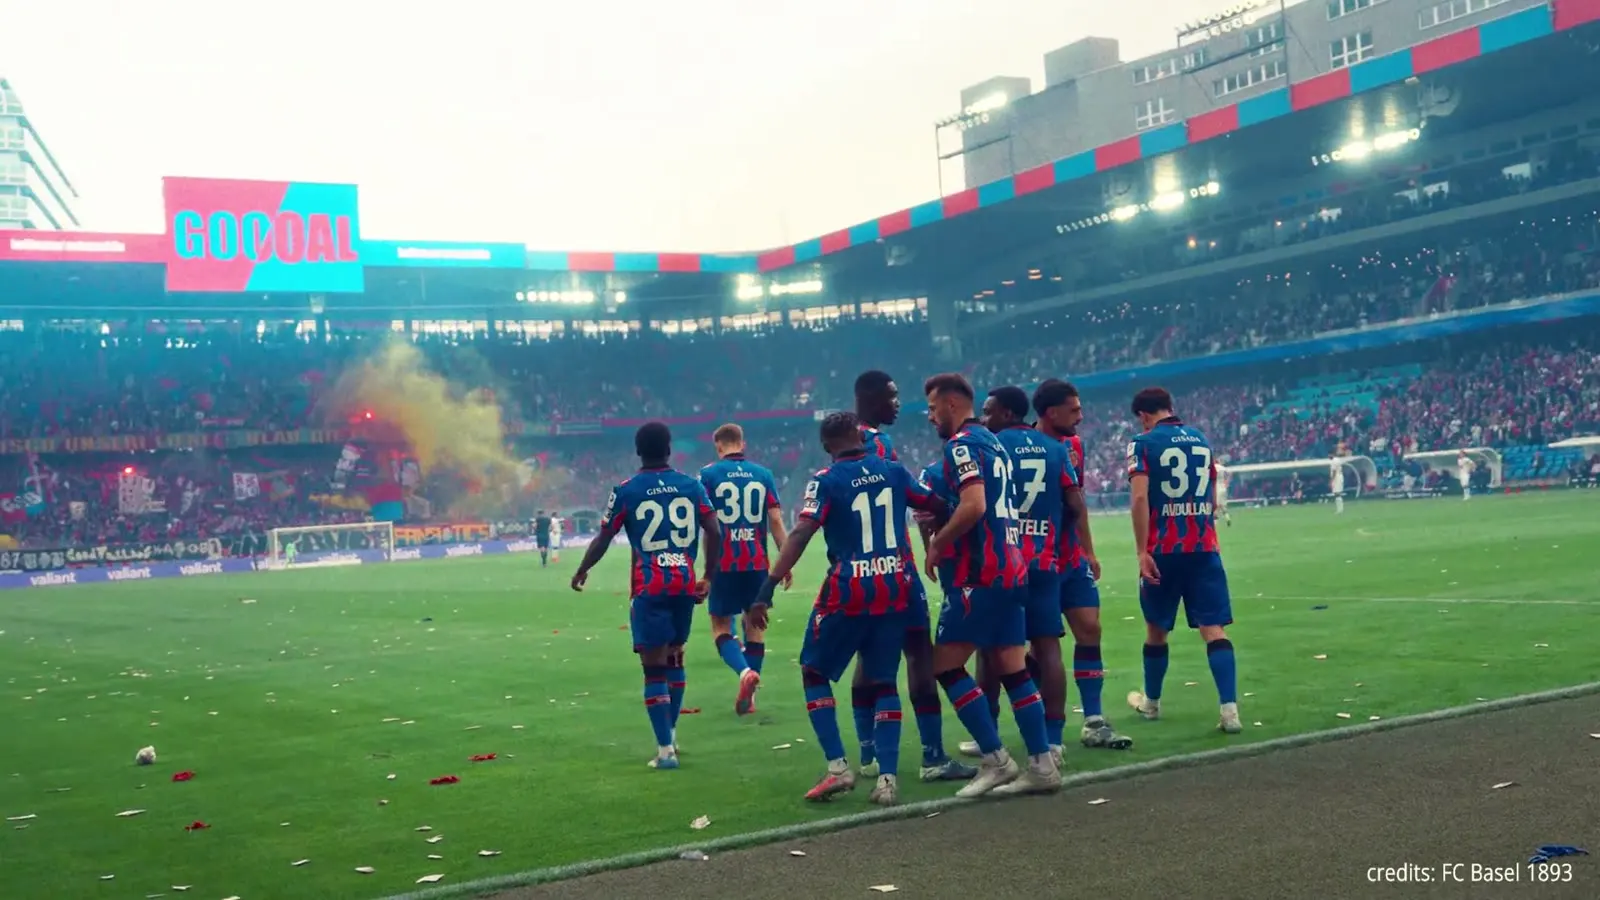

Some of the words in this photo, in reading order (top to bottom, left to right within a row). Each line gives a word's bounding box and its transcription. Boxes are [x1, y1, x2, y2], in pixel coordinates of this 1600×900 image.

[1015, 446, 1046, 454] GISADA
[1160, 446, 1211, 498] 37
[851, 474, 885, 488] GISADA
[646, 486, 679, 496] GISADA
[715, 481, 766, 524] 30
[635, 496, 696, 552] 29
[851, 487, 897, 554] 11
[730, 528, 756, 542] KADE
[107, 565, 151, 581] valiant
[180, 561, 222, 576] valiant
[30, 571, 76, 586] valiant
